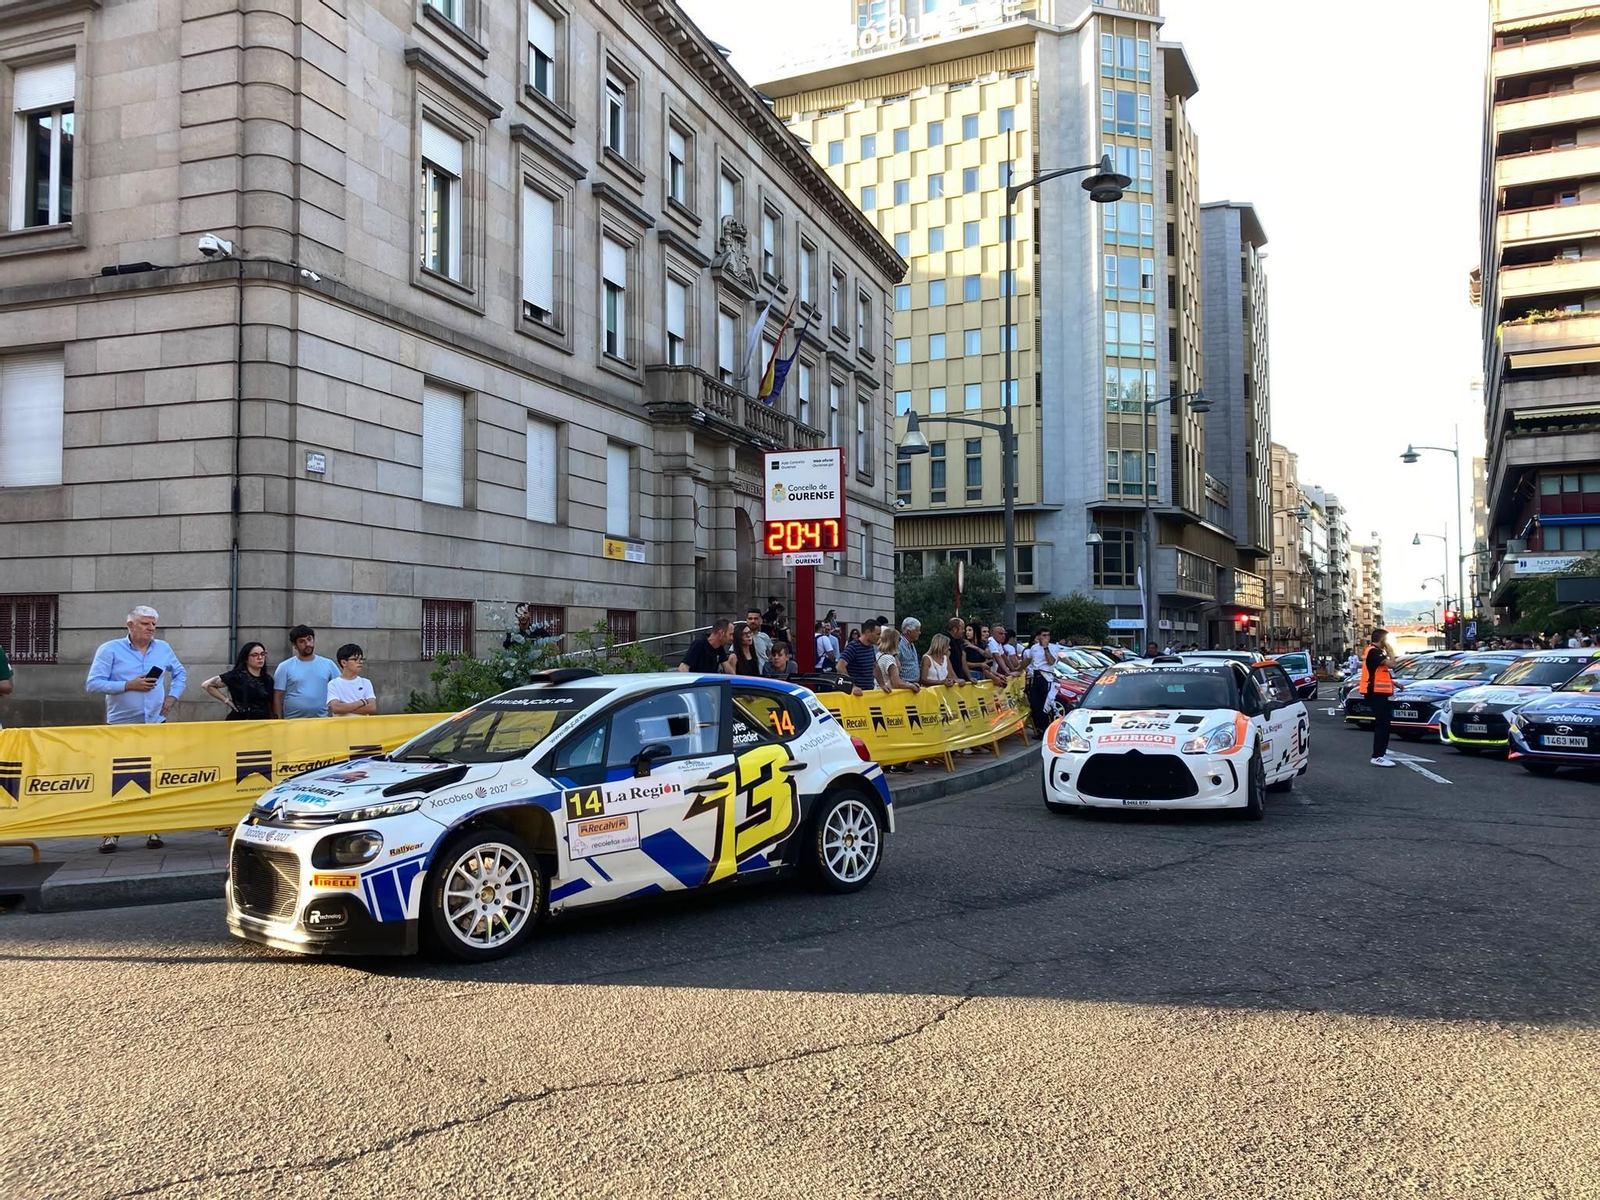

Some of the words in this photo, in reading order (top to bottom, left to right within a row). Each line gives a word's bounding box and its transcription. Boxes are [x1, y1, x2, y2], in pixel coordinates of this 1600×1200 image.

[788, 483, 818, 492] Concello
[788, 491, 835, 501] OURENSE
[1533, 656, 1570, 664] MOTO
[770, 709, 796, 736] 14
[846, 719, 868, 729] Recalvi
[886, 716, 904, 726] Recalvi
[1121, 720, 1171, 730] Cars
[800, 730, 838, 752] ANDBANK
[1100, 733, 1174, 744] LUBRIGOR
[1546, 736, 1567, 745] 1463
[1568, 737, 1586, 746] MNV
[279, 757, 336, 773] Recalvi
[159, 769, 217, 785] Recalvi
[28, 776, 91, 793] Recalvi
[430, 792, 474, 809] Xacobeo
[489, 784, 509, 796] 2027
[570, 790, 603, 817] 14
[606, 791, 627, 804] La
[588, 820, 620, 833] Recalvi
[273, 832, 290, 842] 2027
[591, 838, 621, 849] recoletas
[621, 835, 638, 843] salud
[390, 842, 424, 856] Rallycar
[314, 874, 357, 887] PIRELLI
